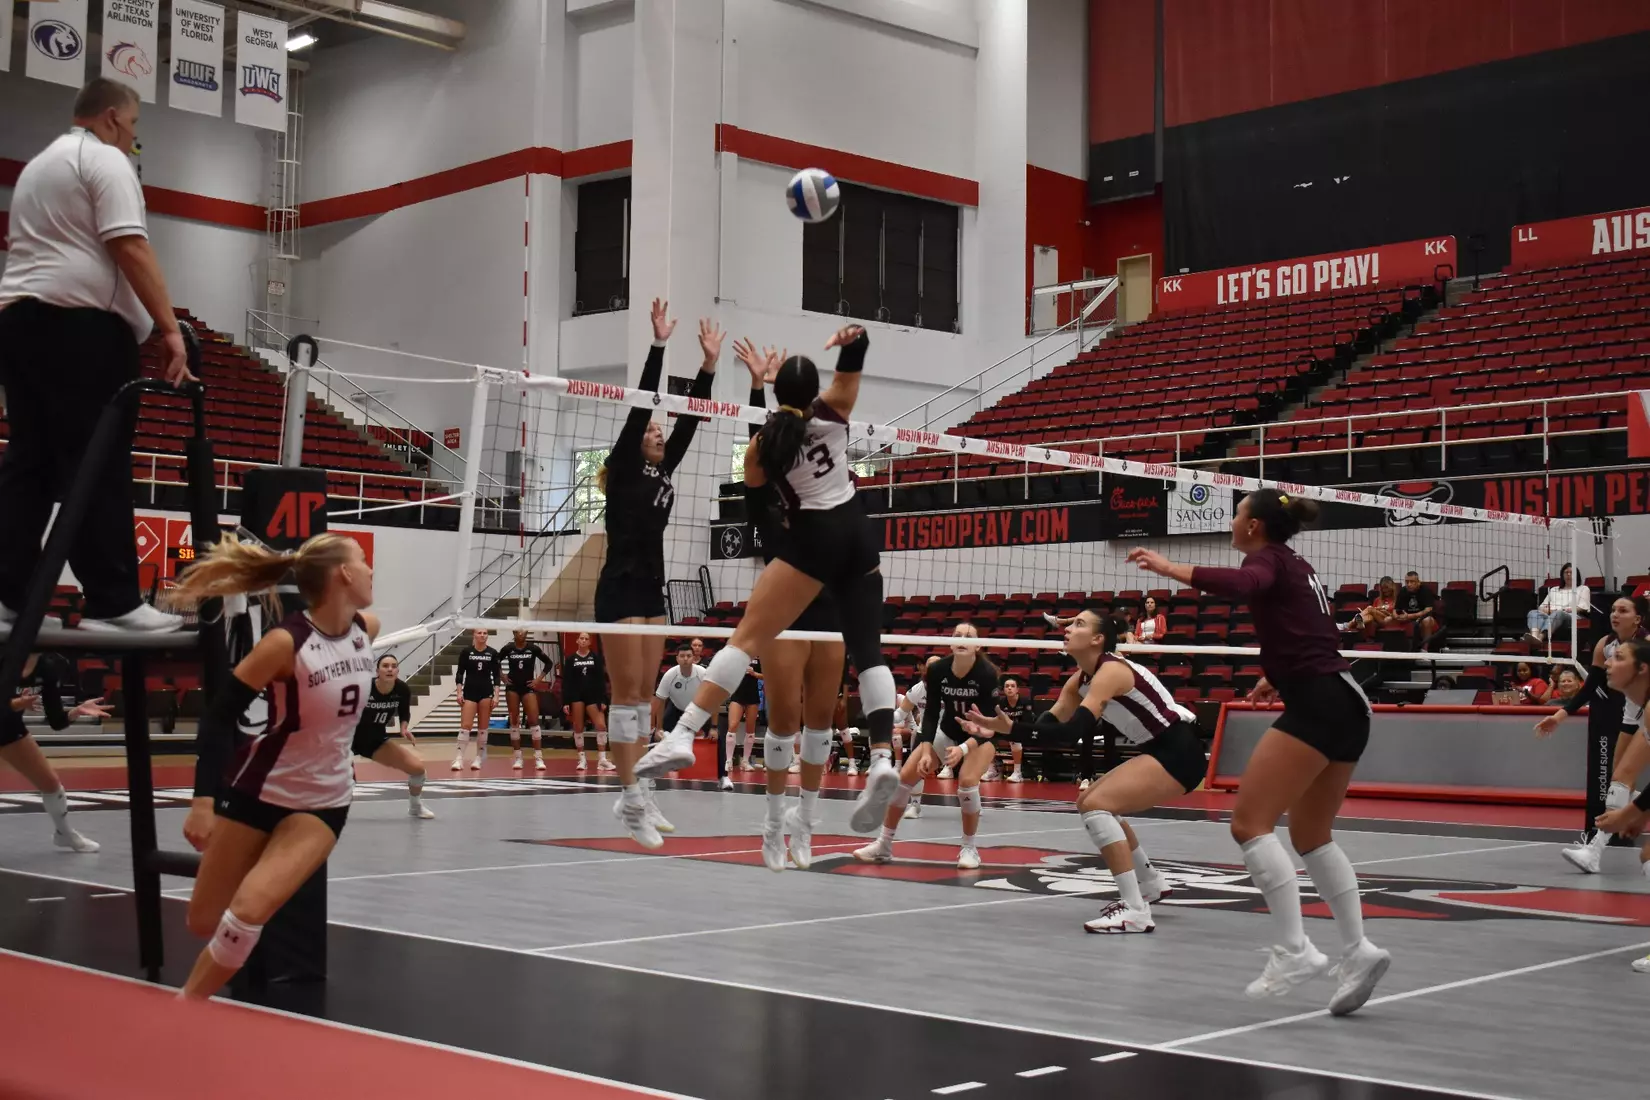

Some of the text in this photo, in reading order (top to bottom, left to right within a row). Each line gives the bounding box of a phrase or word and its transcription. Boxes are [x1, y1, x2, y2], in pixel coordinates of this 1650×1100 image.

[112, 2, 150, 18] OF TEXAS
[176, 8, 220, 25] UNIVERSITY
[107, 10, 152, 28] ARLINGTON
[181, 19, 214, 33] OF WEST
[181, 28, 214, 42] FLORIDA
[252, 28, 273, 39] WEST
[245, 36, 278, 49] GEORGIA
[178, 59, 216, 83] UWF
[242, 65, 281, 94] UWG
[1519, 227, 1538, 242] LL
[1425, 240, 1447, 255] KK
[1163, 279, 1182, 293] KK
[1217, 252, 1379, 305] LET'S GO PEAY!
[567, 380, 625, 401] AUSTIN PEAY
[687, 397, 718, 414] AUSTIN
[720, 403, 740, 417] PEAY
[896, 428, 940, 446] AUSTIN PEAY
[986, 440, 1026, 457] AUSTIN PEAY
[806, 443, 835, 479] 3
[1069, 453, 1089, 466] AUSTIN
[654, 486, 673, 508] 14
[1484, 471, 1650, 517] AUSTIN PE
[1176, 507, 1224, 522] SANGO
[885, 507, 1069, 550] LETSGOPEAY.COM
[1308, 573, 1330, 616] 11
[308, 659, 351, 688] SOUTHERN
[478, 662, 483, 671] 9
[519, 661, 523, 669] 6
[941, 686, 979, 697] COUGARS
[337, 684, 360, 717] 9
[366, 701, 399, 709] COUGARS
[374, 712, 388, 723] 10
[1599, 736, 1608, 765] sports
